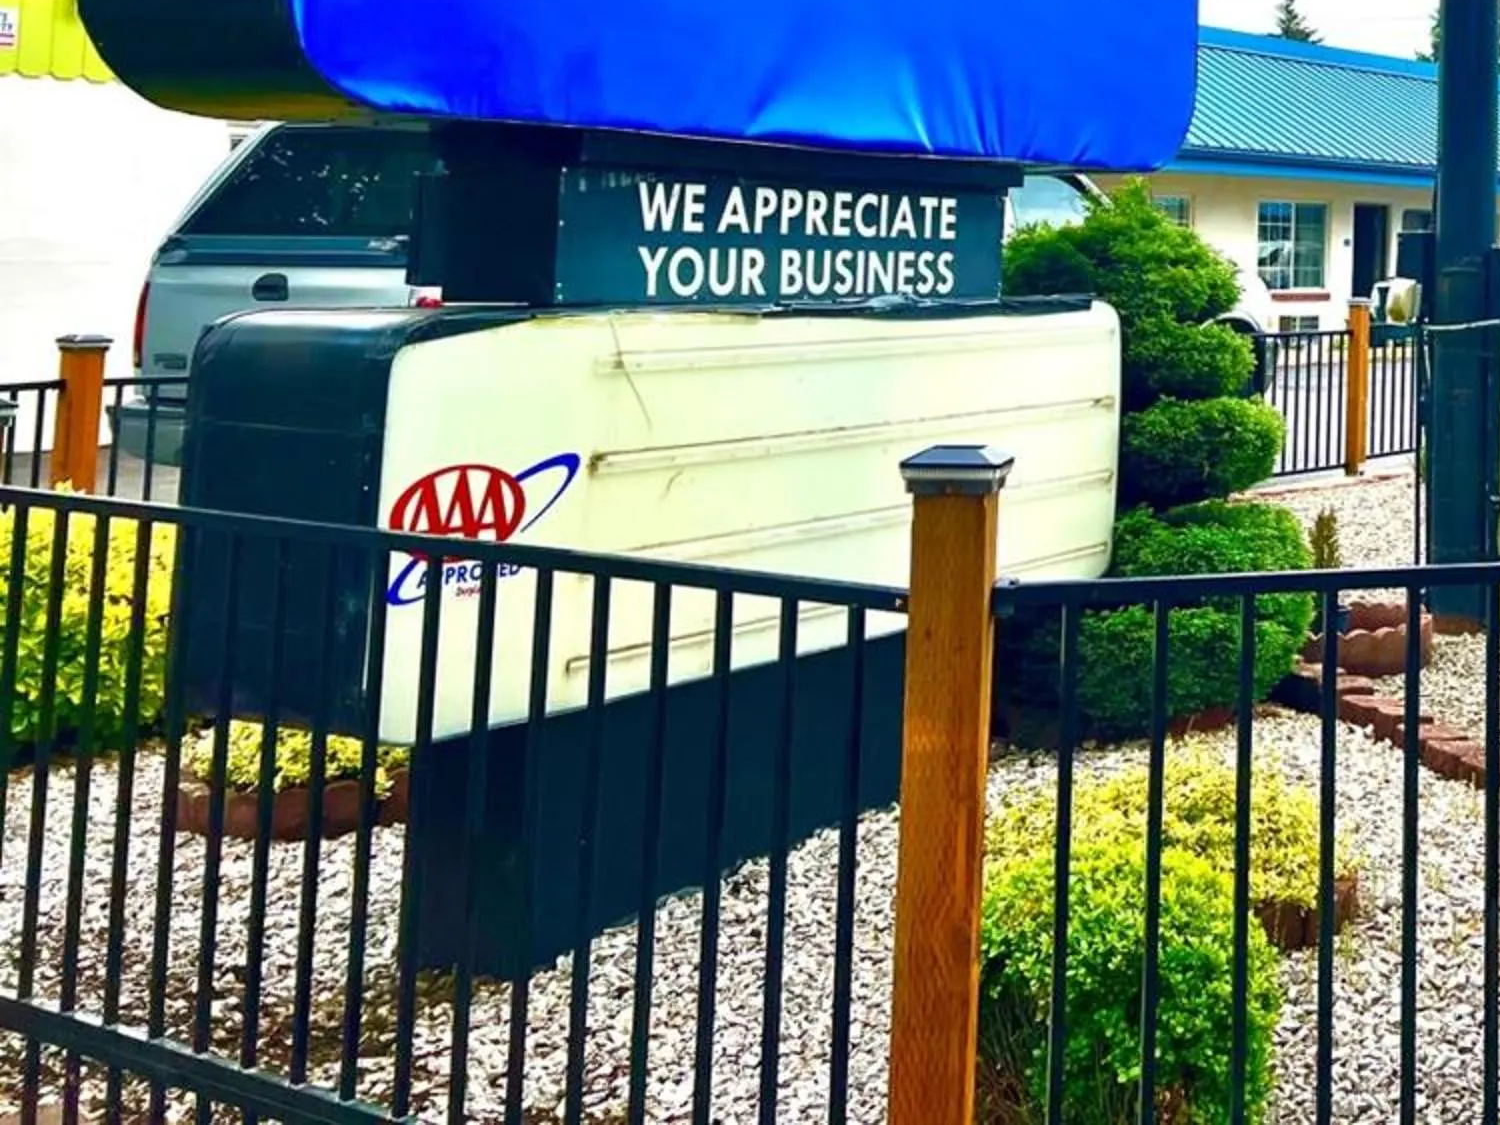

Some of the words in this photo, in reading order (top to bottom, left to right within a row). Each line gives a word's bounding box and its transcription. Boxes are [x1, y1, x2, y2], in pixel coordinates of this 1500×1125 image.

[638, 181, 707, 233] WE
[716, 186, 958, 240] APPRECIATE
[638, 246, 766, 297] YOUR
[779, 249, 954, 296] BUSINESS
[407, 465, 512, 543] AAA
